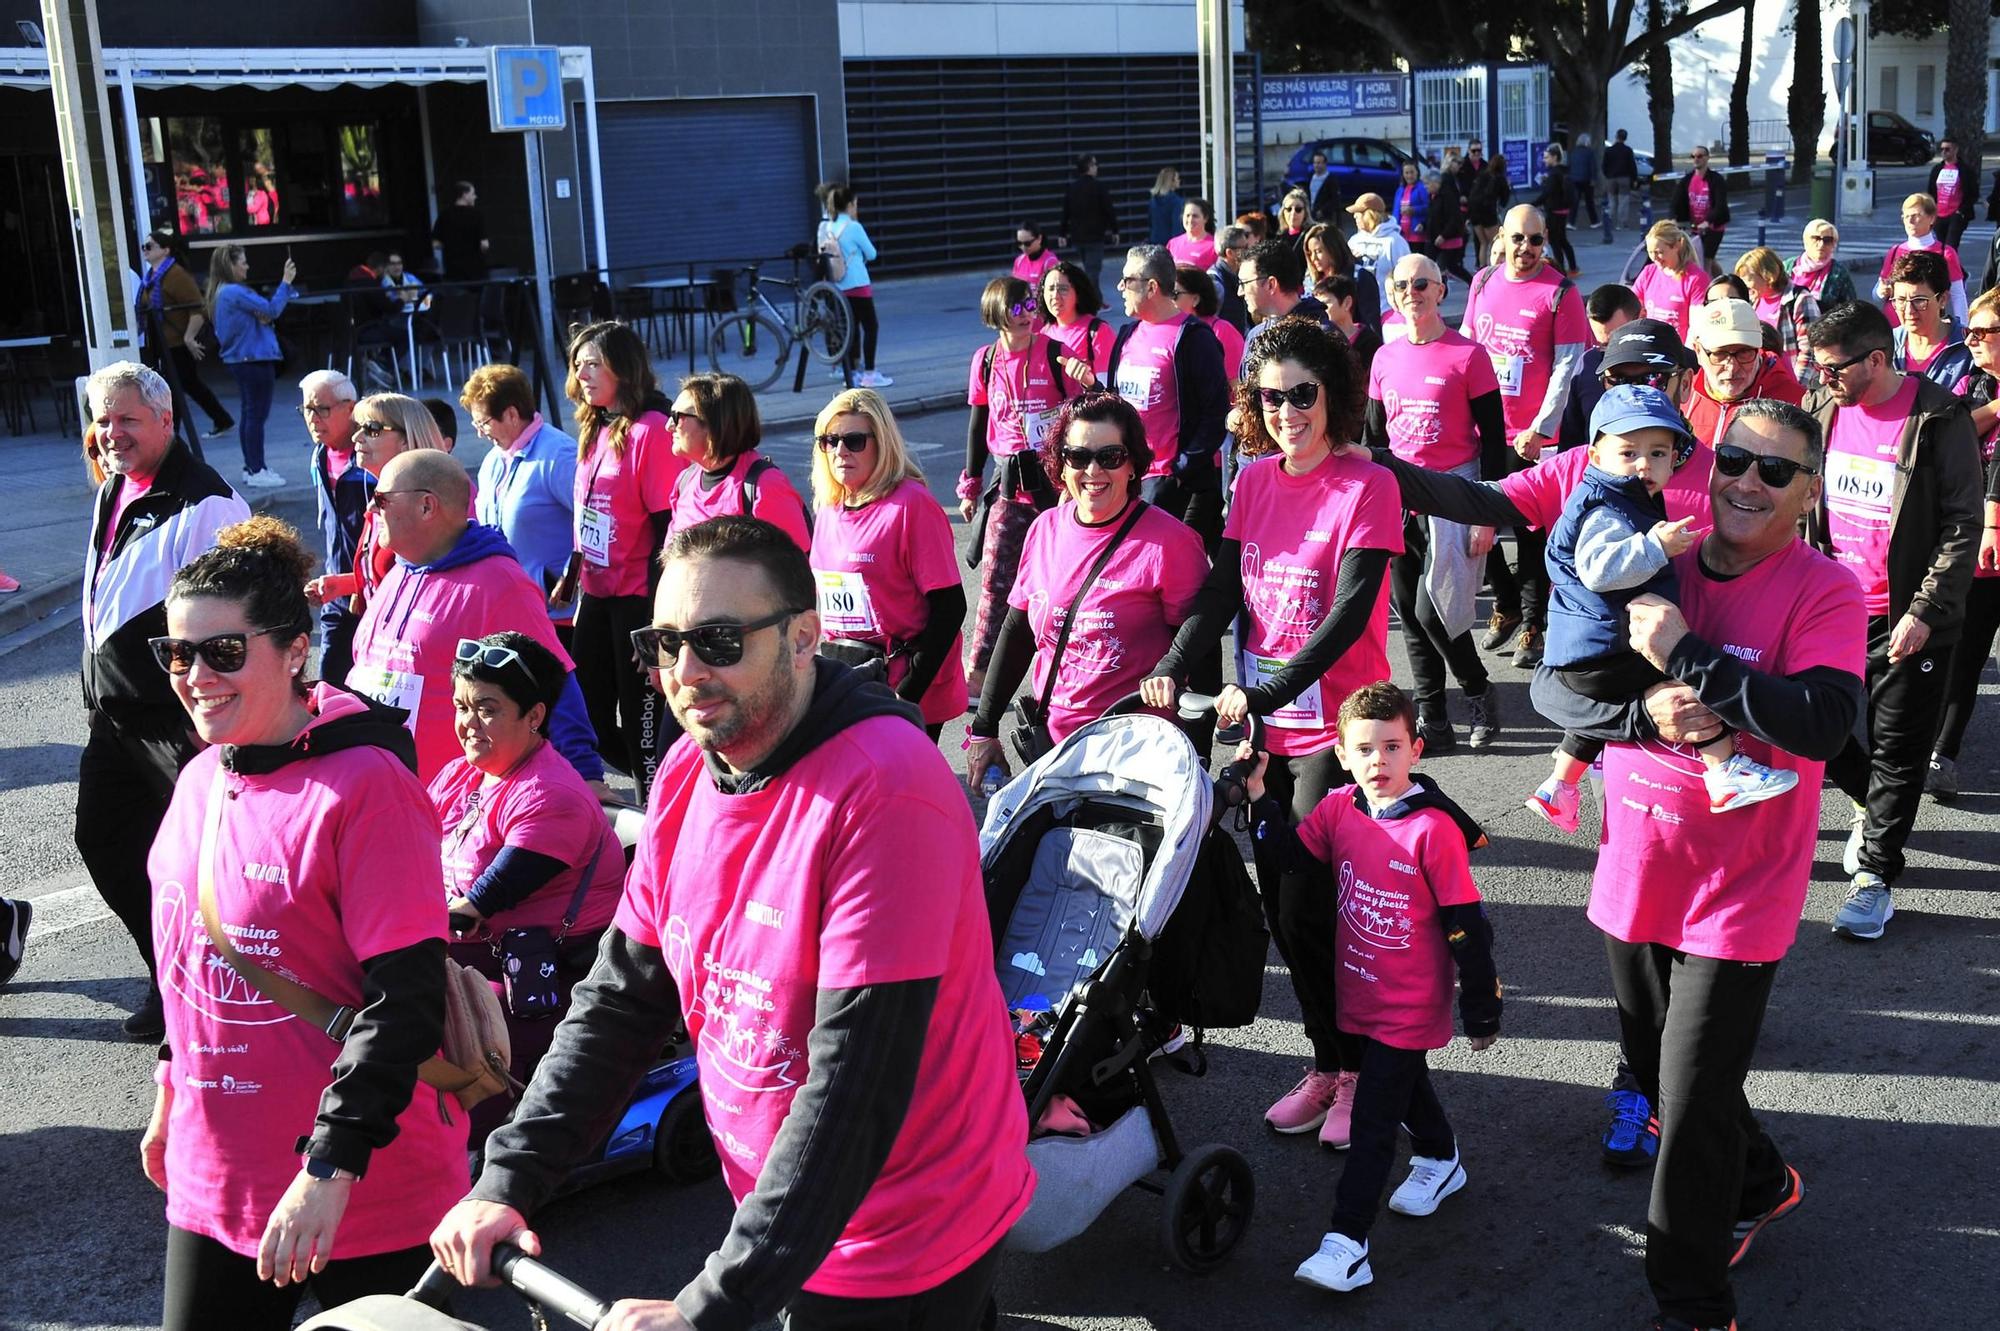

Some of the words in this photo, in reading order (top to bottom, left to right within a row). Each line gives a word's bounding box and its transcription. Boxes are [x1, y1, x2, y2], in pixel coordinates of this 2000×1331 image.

[511, 58, 548, 116] P
[1263, 82, 1284, 94] DES
[1285, 78, 1306, 93] MÁS
[1308, 80, 1348, 92] VUELTAS
[1286, 98, 1293, 109] A
[1295, 97, 1308, 108] LA
[1310, 95, 1351, 108] PRIMERA
[1355, 84, 1364, 109] 1
[1366, 82, 1391, 94] HORA
[1366, 97, 1397, 108] GRATIS
[529, 115, 560, 124] MOTOS
[1838, 474, 1884, 498] 0849
[1285, 565, 1320, 577] camina
[641, 693, 656, 749] Reebok
[1354, 879, 1375, 894] Elche
[1375, 889, 1410, 901] camina
[1355, 890, 1371, 902] rosa
[1371, 897, 1379, 907] y
[1378, 896, 1409, 910] fuerte
[193, 930, 215, 946] ros
[221, 922, 280, 940] camina
